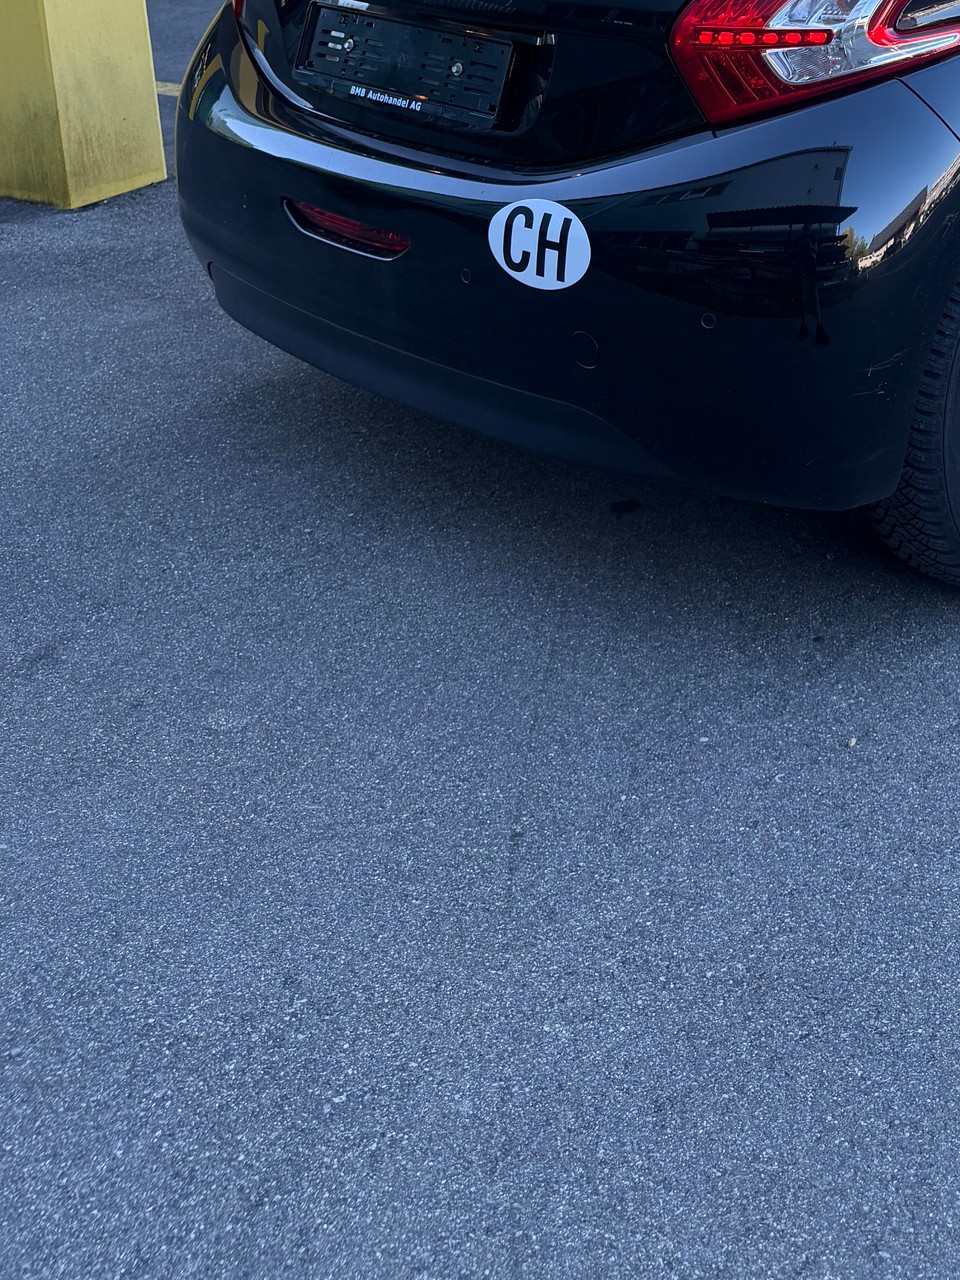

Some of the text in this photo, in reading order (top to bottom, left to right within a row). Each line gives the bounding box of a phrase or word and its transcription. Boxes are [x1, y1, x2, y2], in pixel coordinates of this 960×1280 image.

[350, 85, 422, 111] BMB Autohandel AG
[503, 206, 573, 283] CH
